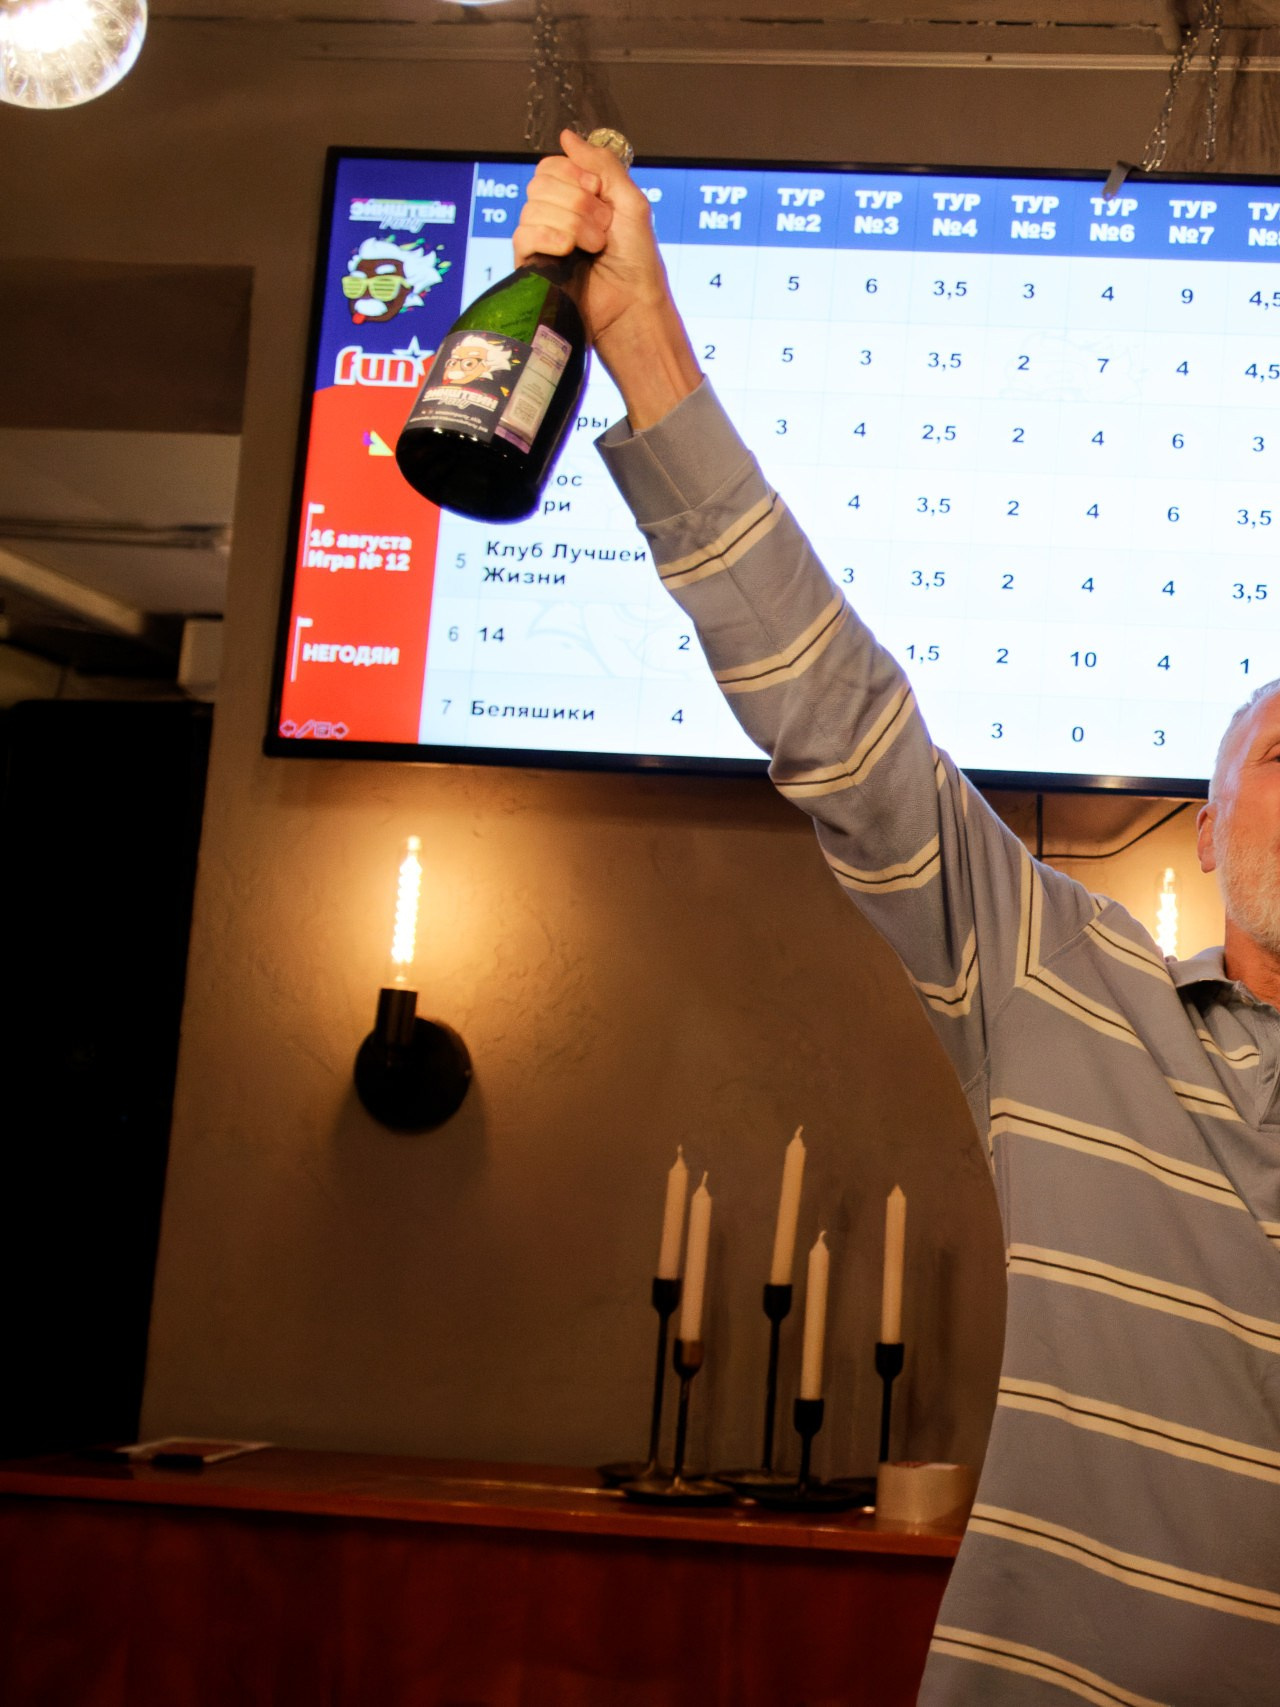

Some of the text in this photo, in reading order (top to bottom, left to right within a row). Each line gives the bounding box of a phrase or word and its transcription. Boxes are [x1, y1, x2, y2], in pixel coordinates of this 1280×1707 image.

[475, 178, 519, 200] Мес
[699, 185, 748, 205] ТУР
[777, 187, 825, 207] ТУР
[854, 189, 903, 209] ТУР
[932, 192, 981, 212] ТУР
[1011, 194, 1060, 214] ТУР
[1089, 197, 1138, 217] ТУР
[1169, 199, 1218, 219] ТУР
[481, 207, 507, 223] то
[698, 210, 742, 230] №1
[776, 212, 822, 233] №2
[854, 215, 899, 235] №3
[932, 217, 978, 237] №4
[1010, 220, 1057, 240] №5
[1089, 222, 1135, 243] №6
[1168, 225, 1215, 245] №7
[484, 266, 493, 282] 1
[708, 273, 722, 289] 4
[787, 275, 800, 292] 5
[864, 277, 878, 294] 6
[932, 279, 968, 299] 3,5
[1022, 282, 1035, 300] 3
[1100, 285, 1115, 302] 4
[1180, 287, 1195, 305] 9
[334, 346, 419, 388] fun
[703, 344, 717, 360] 2
[781, 346, 794, 363] 5
[859, 349, 872, 366] 3
[927, 351, 962, 370] 3,5
[1016, 354, 1031, 371] 2
[1096, 357, 1110, 374] 7
[1175, 360, 1190, 377] 4
[1244, 362, 1280, 383] 4,5
[576, 415, 609, 432] ры
[775, 418, 788, 436] 3
[852, 421, 867, 438] 4
[921, 423, 957, 444] 2,5
[1011, 427, 1025, 444] 2
[1090, 430, 1105, 447] 4
[1171, 432, 1185, 450] 6
[1252, 435, 1265, 453] 3
[543, 500, 572, 516] ри
[847, 494, 861, 510] 4
[916, 496, 951, 516] 3,5
[1006, 499, 1020, 517] 2
[1085, 503, 1100, 520] 4
[1166, 505, 1181, 523] 6
[1236, 508, 1273, 529] 3,5
[309, 529, 413, 554] 16 августа
[307, 550, 357, 572] Игра
[384, 553, 411, 572] 12
[455, 540, 648, 569] 5 Клуб Лучшей
[481, 565, 566, 585] Жизни
[841, 566, 856, 584] 3
[910, 569, 946, 591] 3,5
[1000, 573, 1015, 591] 2
[1080, 576, 1095, 593] 4
[1161, 579, 1176, 597] 4
[1231, 582, 1269, 604] 3,5
[301, 642, 401, 667] НЕГОДЯИ
[447, 625, 1250, 675] 6 14 2 1,5 2 10 4 1
[440, 698, 1166, 747] 7 Беляшики 4 3 0 3
